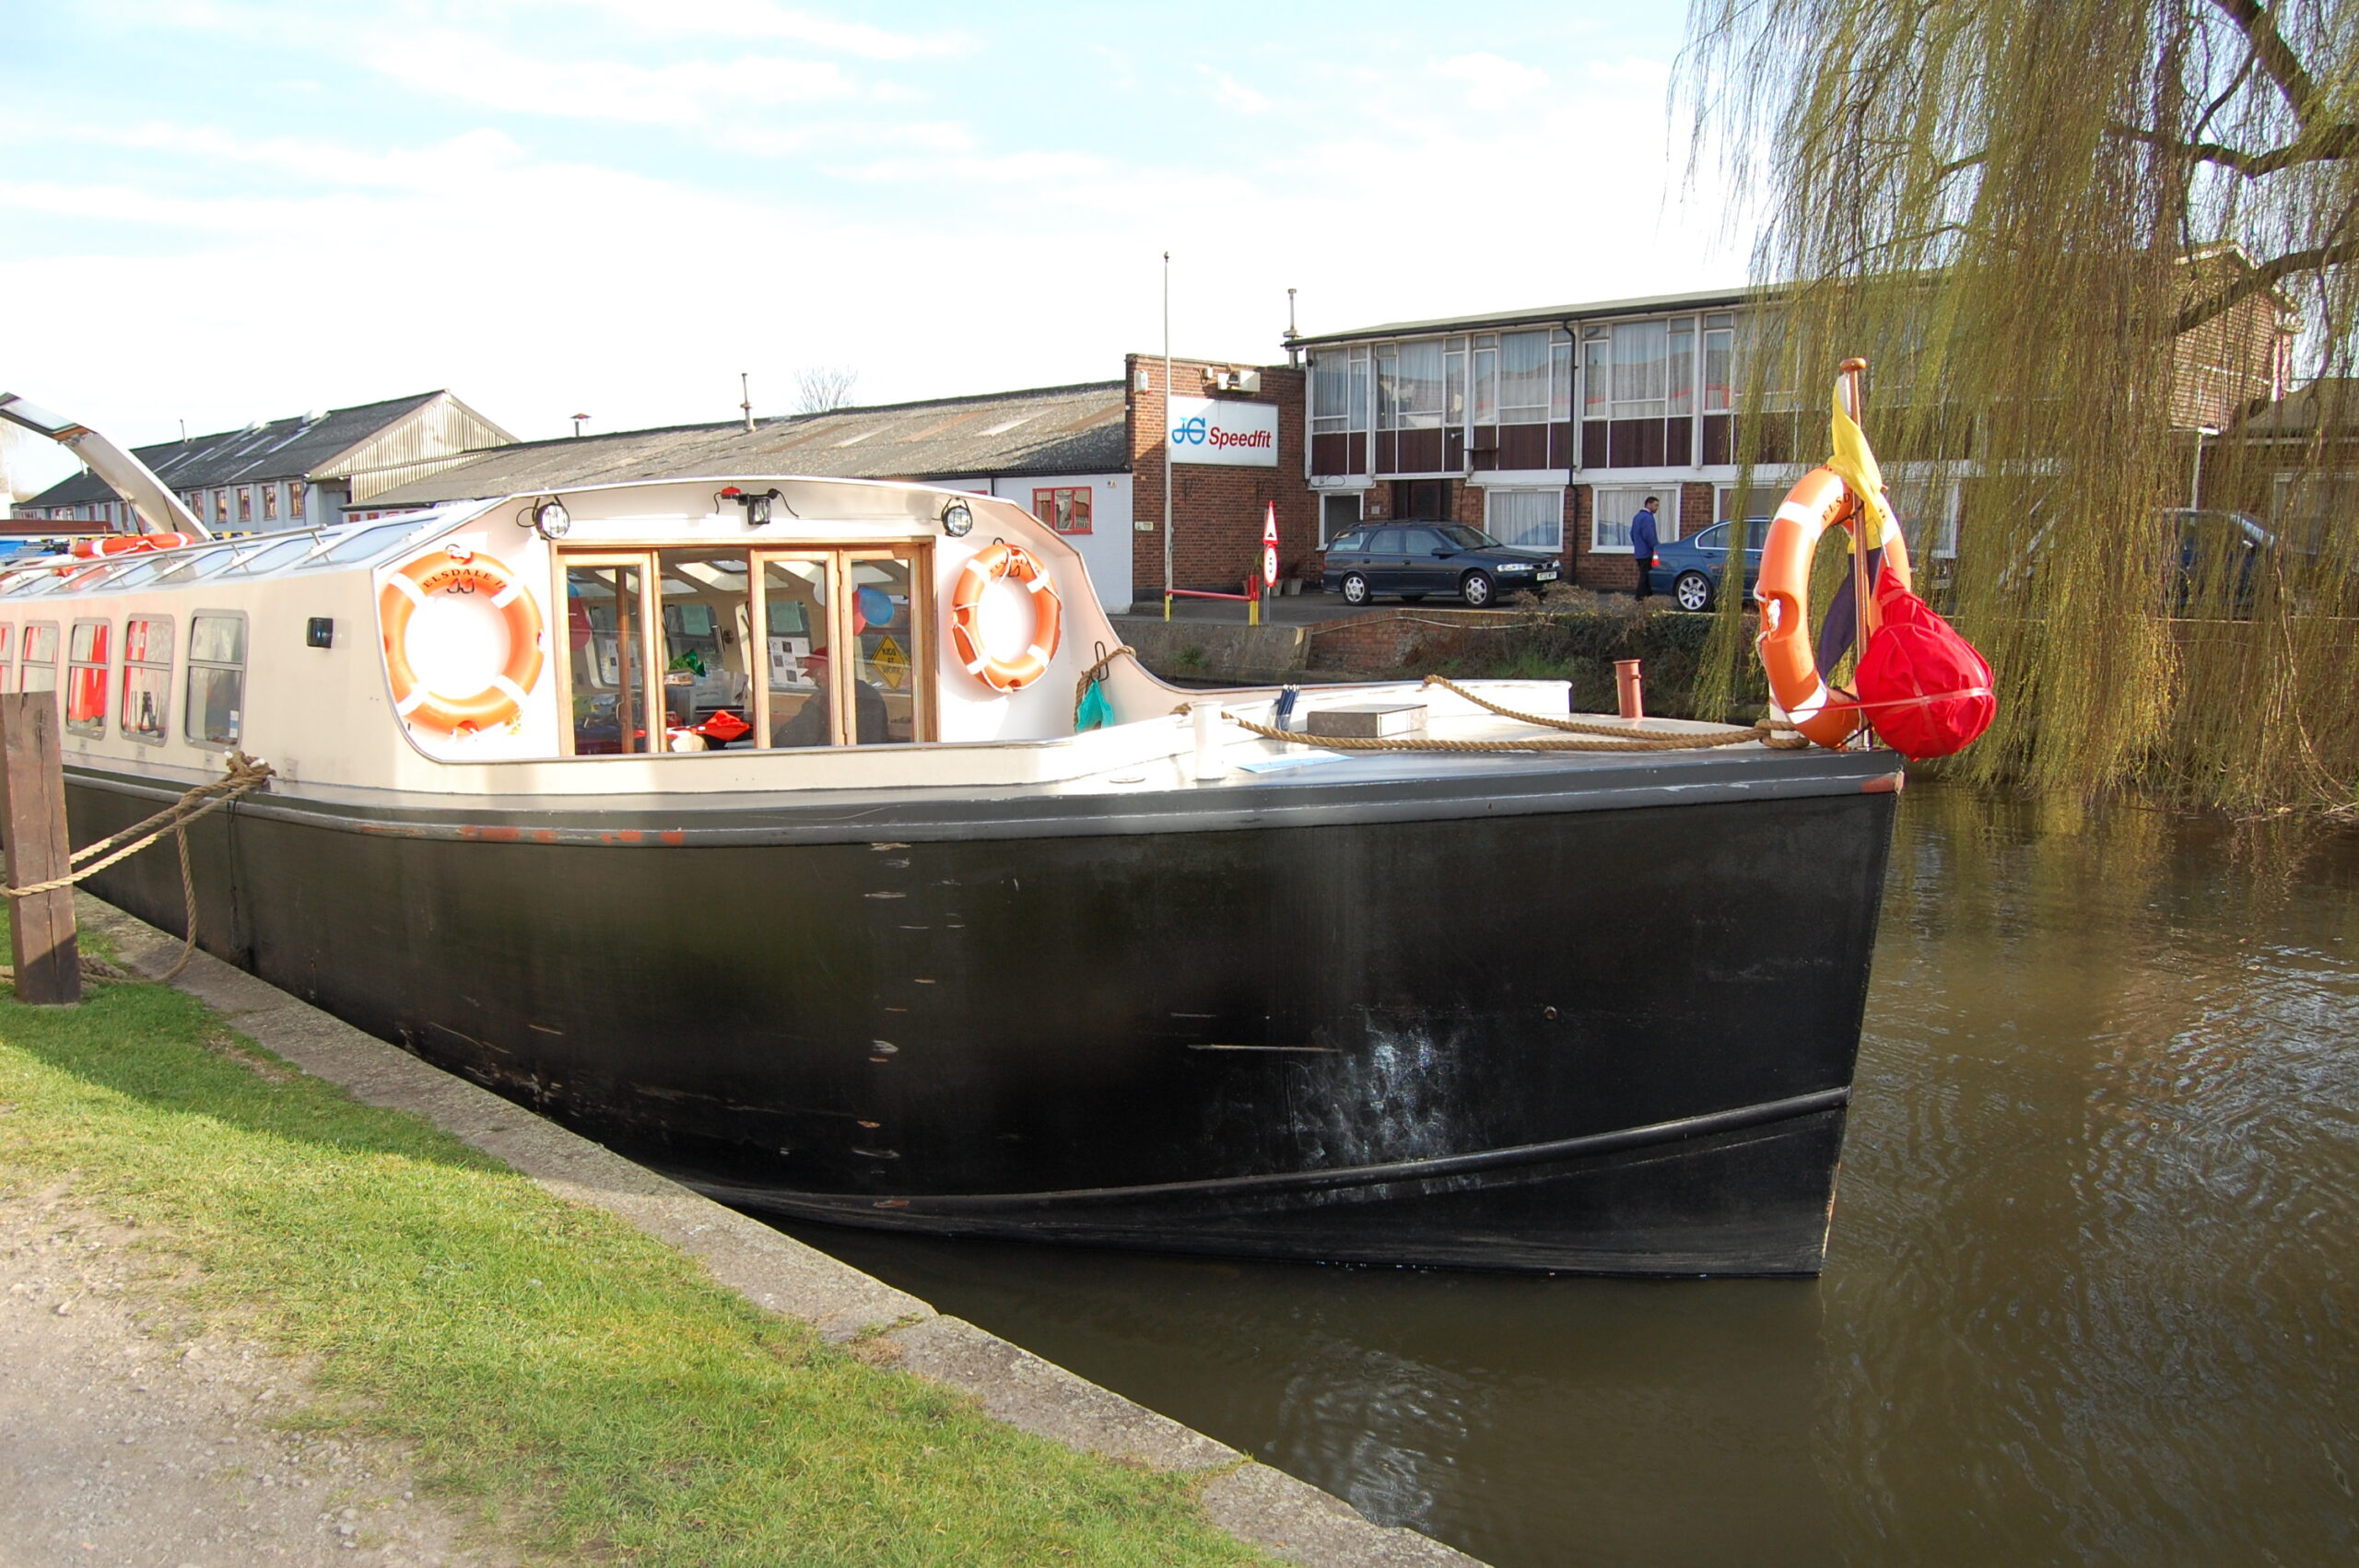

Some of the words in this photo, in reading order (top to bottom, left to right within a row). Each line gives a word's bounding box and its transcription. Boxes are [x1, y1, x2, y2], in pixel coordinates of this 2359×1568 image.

[1209, 427, 1272, 450] Speedfit
[1822, 492, 1851, 521] ELSD
[423, 568, 492, 588] ELSDALE
[495, 580, 508, 590] II
